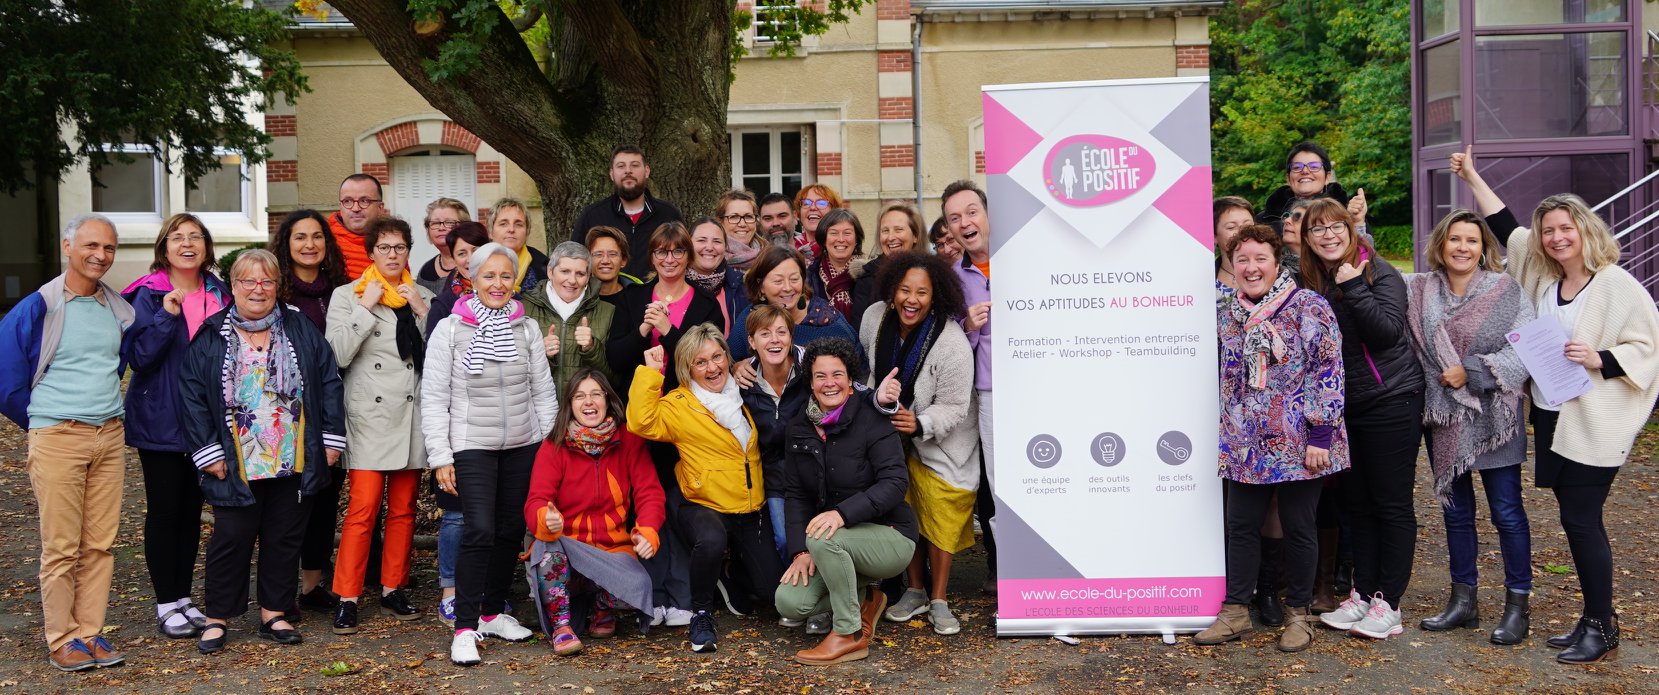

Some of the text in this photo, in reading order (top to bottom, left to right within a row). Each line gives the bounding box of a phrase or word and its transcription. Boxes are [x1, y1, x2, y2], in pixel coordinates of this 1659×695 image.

[1081, 146, 1137, 170] ÉCOLE DU
[1083, 168, 1140, 192] POSITIF
[1051, 272, 1152, 285] NOUS ELEVONS
[1007, 295, 1193, 311] VOS APTITUDES AU BONHEUR
[1008, 336, 1062, 346] Formation
[1075, 335, 1140, 345] Intervention
[1145, 334, 1200, 344] entreprise
[1012, 349, 1046, 358] Atelier
[1059, 348, 1112, 358] Workshop
[1125, 346, 1196, 357] Teambuilding
[1042, 476, 1070, 486] équipe
[1107, 474, 1130, 482] outils
[1173, 474, 1193, 482] clefs
[1027, 486, 1066, 495] d'experts
[1156, 483, 1196, 493] du positif
[1021, 586, 1202, 600] www.ecole-du-positif.com
[1065, 606, 1084, 616] DES
[1087, 606, 1133, 616] SCIENCES
[1137, 606, 1150, 615] DU
[1154, 605, 1199, 615] BONHEUR
